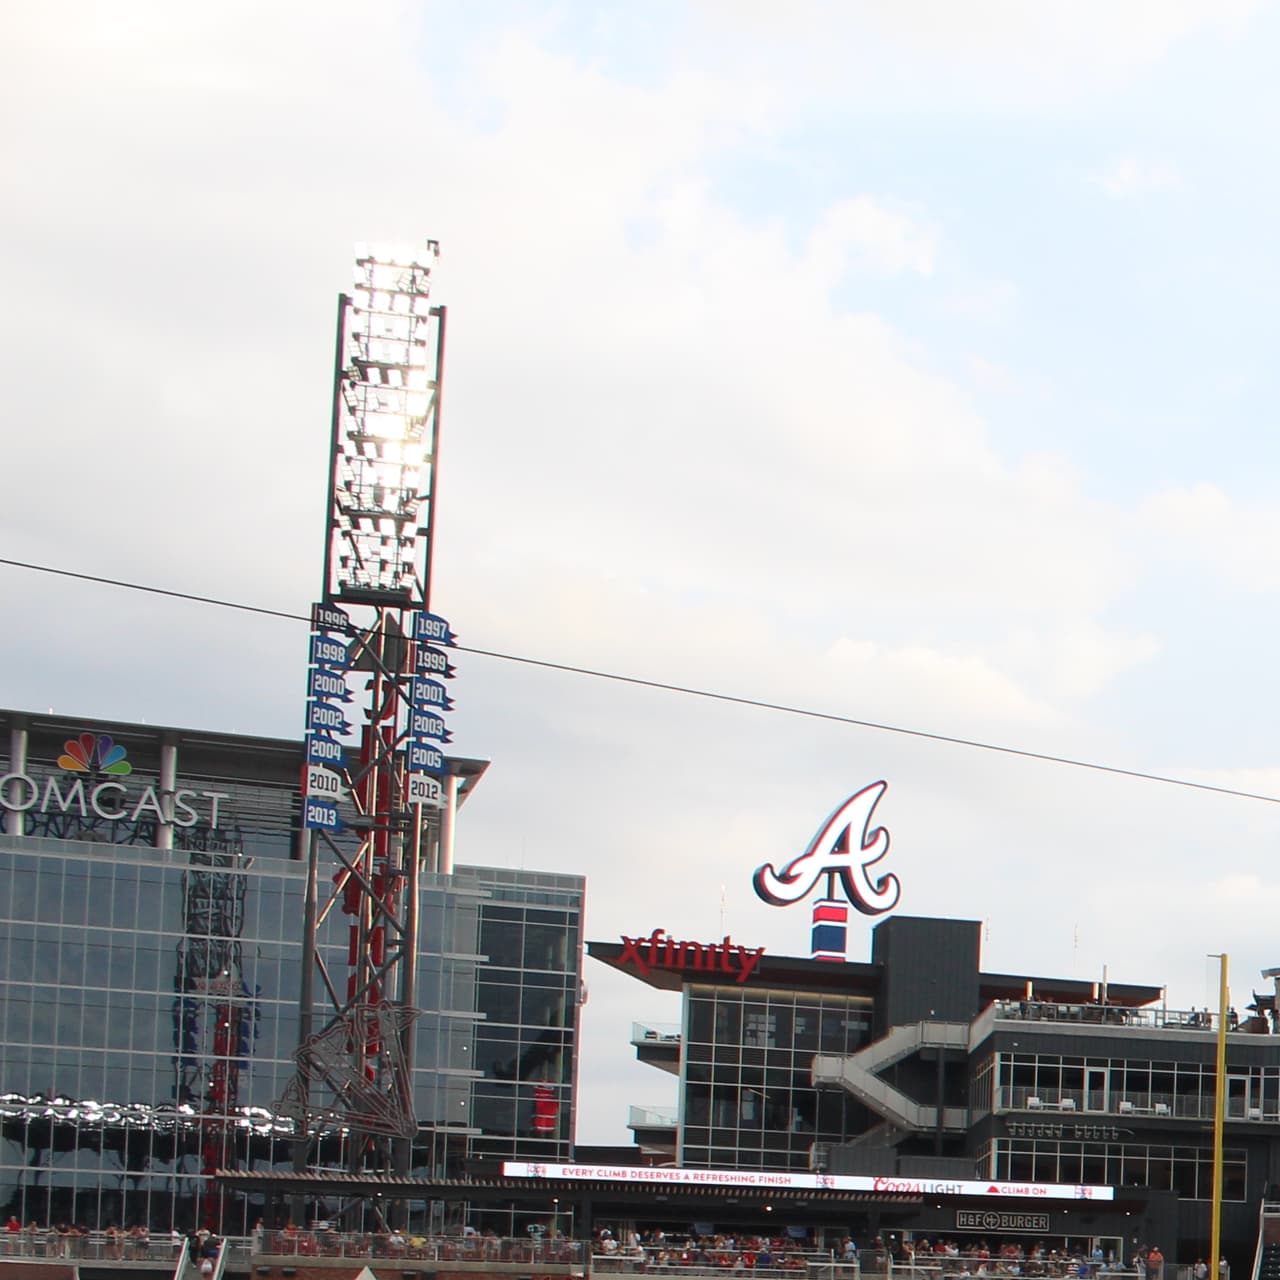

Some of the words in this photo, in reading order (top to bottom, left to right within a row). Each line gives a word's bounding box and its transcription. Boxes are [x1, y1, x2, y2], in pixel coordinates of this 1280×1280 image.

[419, 617, 447, 639] 1997
[316, 642, 346, 663] 1998
[417, 649, 446, 670] 1999
[314, 674, 345, 695] 2000
[416, 682, 444, 702] 2001
[312, 706, 344, 727] 2002
[414, 714, 443, 735] 2003
[311, 739, 342, 761] 2004
[412, 747, 442, 768] 2005
[310, 772, 338, 793] 2010
[411, 779, 439, 800] 2012
[0, 773, 230, 830] OMCAST
[307, 805, 338, 826] 2013
[617, 929, 765, 982] xfinity
[562, 1167, 594, 1177] EVERY
[597, 1168, 627, 1178] CLIMB
[630, 1169, 681, 1181] DESERVES
[684, 1173, 691, 1181] A
[693, 1173, 755, 1184] REFRESHING
[758, 1176, 791, 1185] FINISH
[873, 1175, 922, 1194] Coors
[922, 1184, 964, 1195] LIGHT
[1001, 1186, 1030, 1195] CLIMB
[1032, 1187, 1047, 1196] ON
[960, 1213, 982, 1226] H&F
[1001, 1215, 1047, 1229] BURGER
